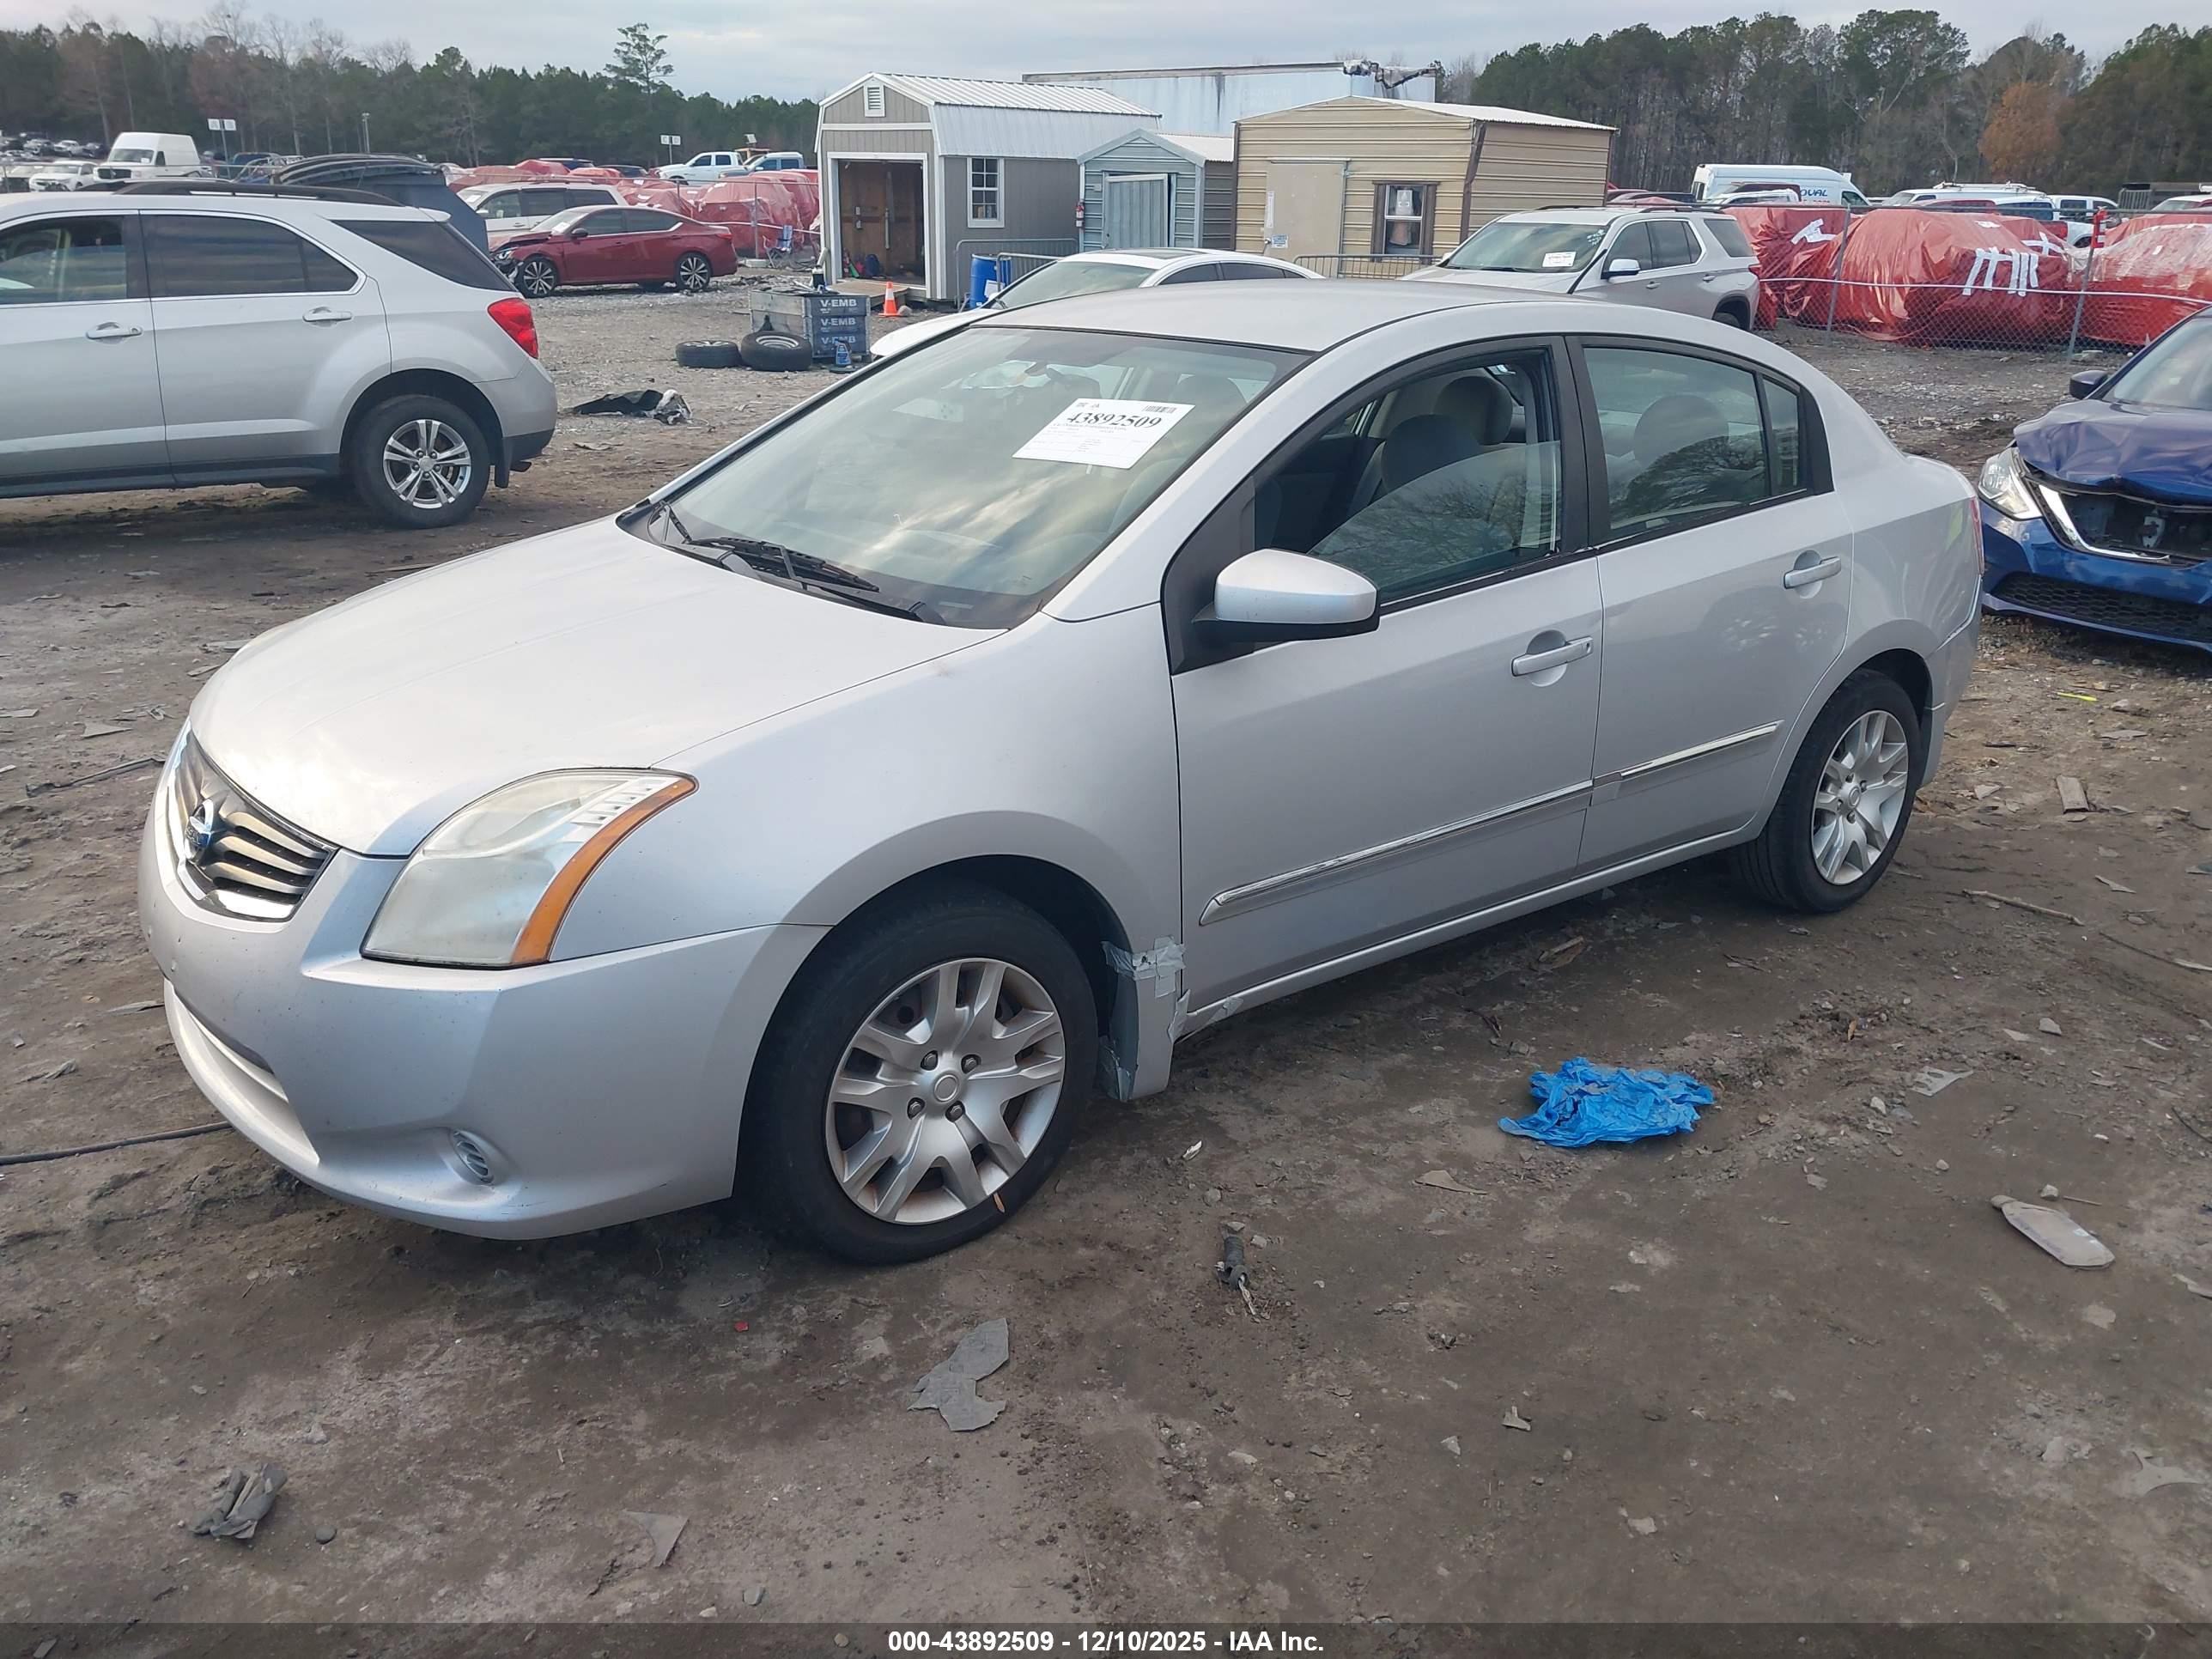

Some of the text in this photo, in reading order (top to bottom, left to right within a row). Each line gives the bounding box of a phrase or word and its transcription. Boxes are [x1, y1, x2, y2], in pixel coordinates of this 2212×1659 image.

[820, 299, 857, 307] V-EMB
[820, 318, 856, 326] V-EMB
[1066, 411, 1162, 428] 43892509
